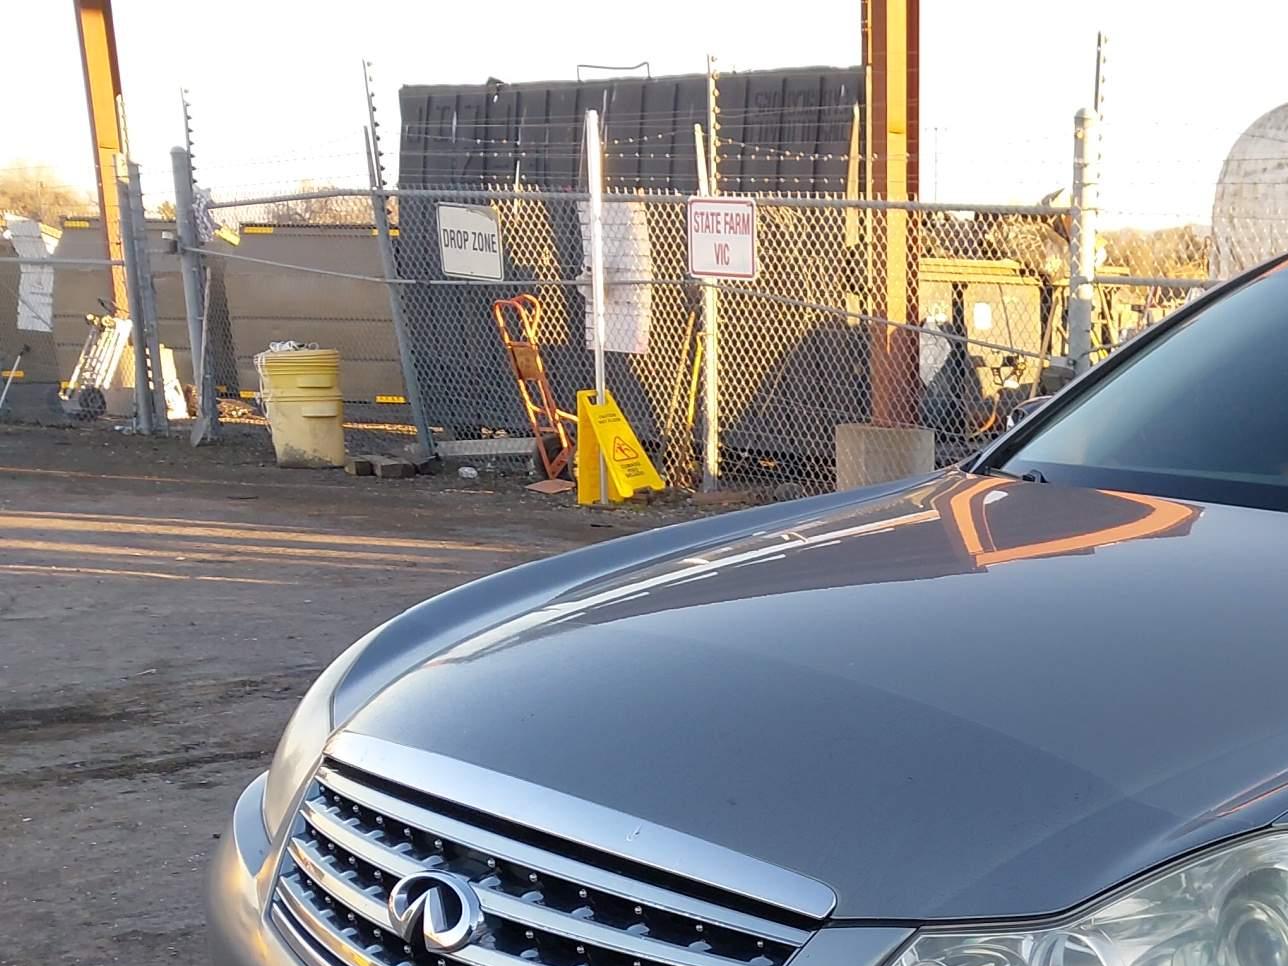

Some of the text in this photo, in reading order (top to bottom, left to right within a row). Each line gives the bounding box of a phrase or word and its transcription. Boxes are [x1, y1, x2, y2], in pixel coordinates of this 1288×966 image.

[693, 210, 750, 235] STATE FARM
[442, 228, 498, 254] DROP ZONE
[714, 242, 730, 266] VIC
